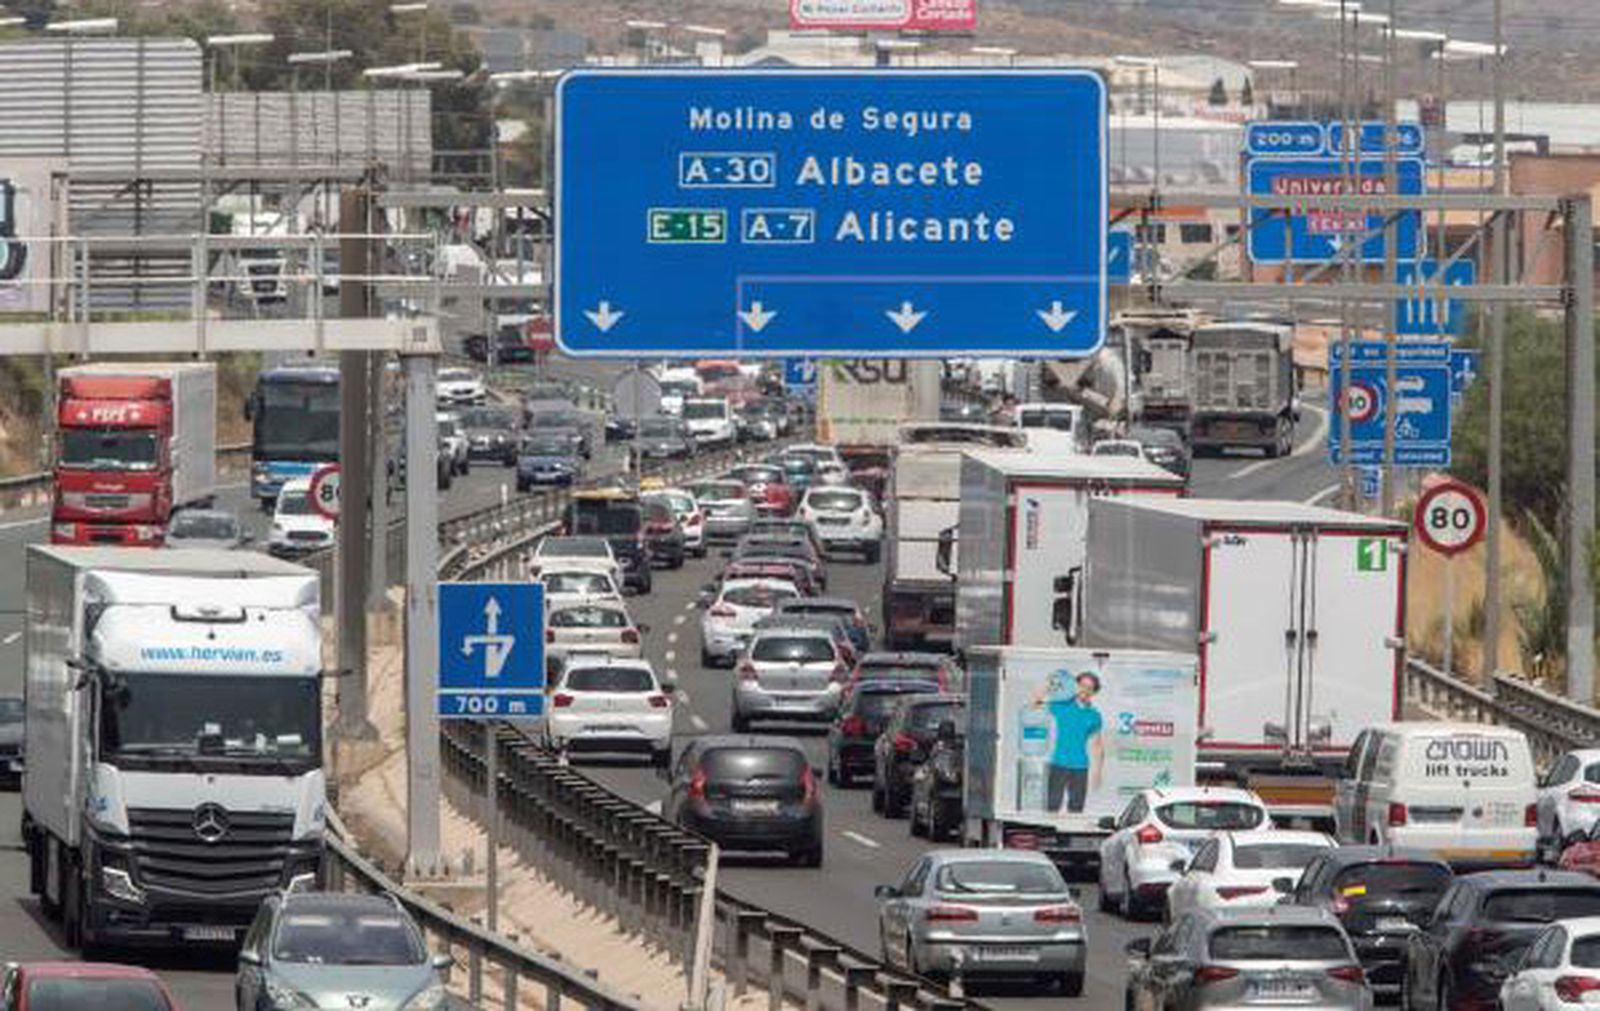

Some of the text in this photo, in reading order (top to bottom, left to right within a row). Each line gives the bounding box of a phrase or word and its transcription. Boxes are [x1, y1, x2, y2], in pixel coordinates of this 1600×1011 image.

[689, 107, 972, 136] Molina de Segura
[1256, 132, 1293, 146] 200
[685, 156, 983, 186] A-30 Albacete
[652, 211, 1015, 242] E-15 A-7 Alicante
[1431, 509, 1470, 530] 80
[1364, 539, 1384, 569] 1
[140, 644, 284, 664] www.hervian.es
[454, 695, 527, 713] 700 m
[1424, 763, 1509, 778] lift trucks
